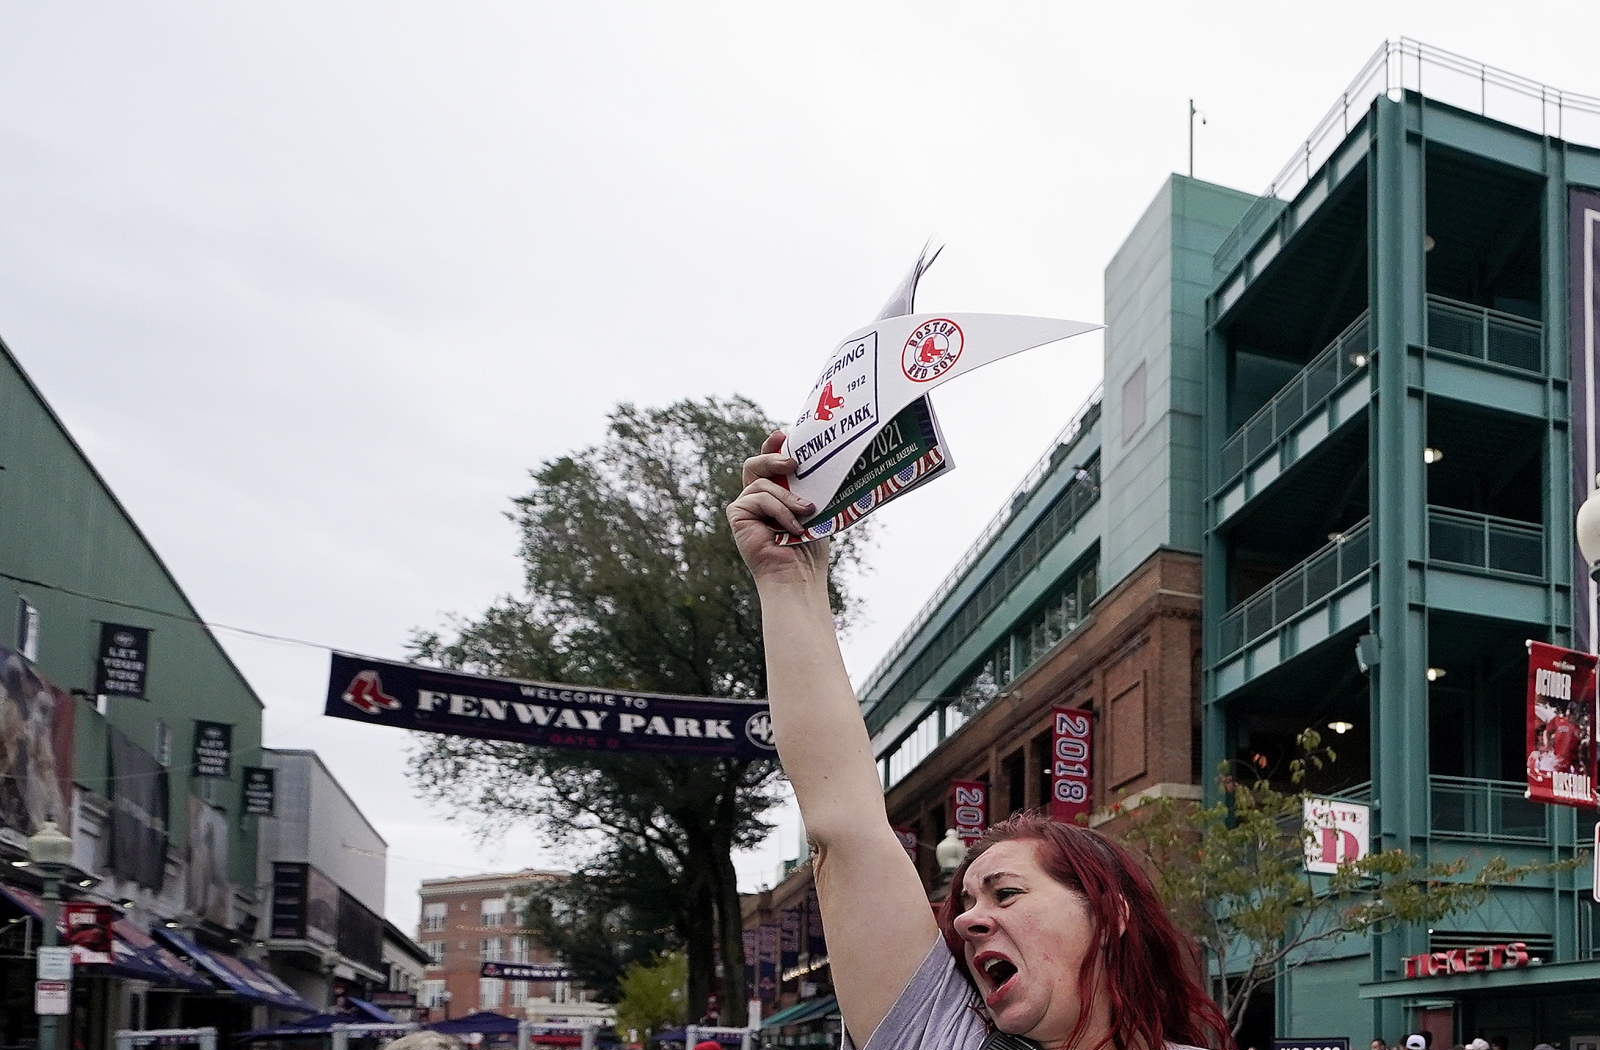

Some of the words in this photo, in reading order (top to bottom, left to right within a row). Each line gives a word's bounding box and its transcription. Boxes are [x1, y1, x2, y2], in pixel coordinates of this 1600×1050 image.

[909, 322, 956, 347] BOSTON
[810, 343, 865, 394] NTERING
[846, 374, 867, 392] 1912
[908, 364, 928, 379] RED
[933, 352, 957, 375] SOX
[794, 423, 837, 464] FENWAY
[840, 403, 872, 434] PARK
[871, 420, 904, 463] 2021
[416, 688, 610, 731] FENWAY
[618, 712, 736, 740] PARK
[519, 685, 616, 707] WELCOME
[622, 696, 648, 709] TO
[1054, 712, 1090, 804] 2018
[955, 786, 984, 839] 201
[1319, 827, 1359, 865] D
[1401, 942, 1529, 979] TICKETS
